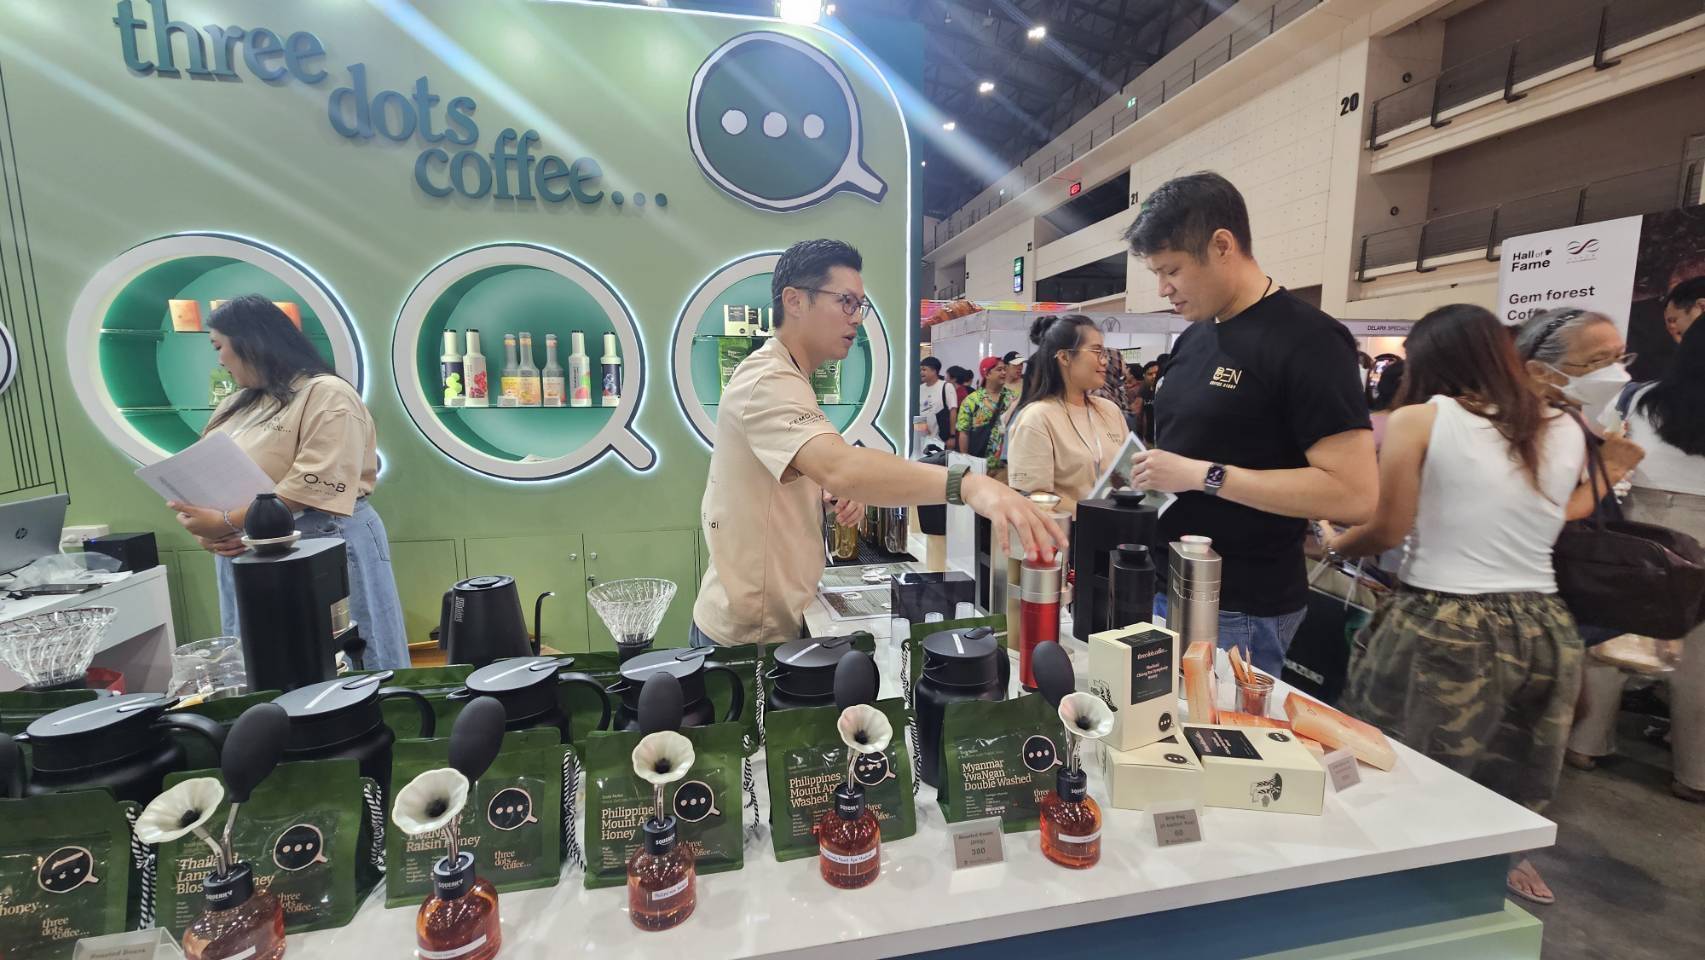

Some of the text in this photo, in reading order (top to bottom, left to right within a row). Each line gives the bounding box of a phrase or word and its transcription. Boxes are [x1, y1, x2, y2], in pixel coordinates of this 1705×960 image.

[112, 0, 328, 84] three
[327, 62, 479, 146] dots
[1340, 92, 1359, 116] 20
[1131, 191, 1139, 206] 21
[1513, 249, 1535, 261] Hall
[1511, 258, 1551, 272] Fame
[1508, 285, 1596, 305] Gem forest
[961, 758, 1005, 774] Myanmar
[789, 772, 841, 789] Philippines
[963, 768, 1006, 784] YwaNgan
[964, 773, 1032, 791] Double Washed
[790, 783, 821, 799] Mount
[790, 793, 829, 808] Washed
[602, 804, 655, 820] Philippine
[602, 816, 636, 831] Mount
[601, 828, 636, 841] Honey
[406, 838, 442, 852] Raisin
[494, 850, 516, 859] three
[178, 870, 211, 883] Lann
[42, 917, 69, 928] three
